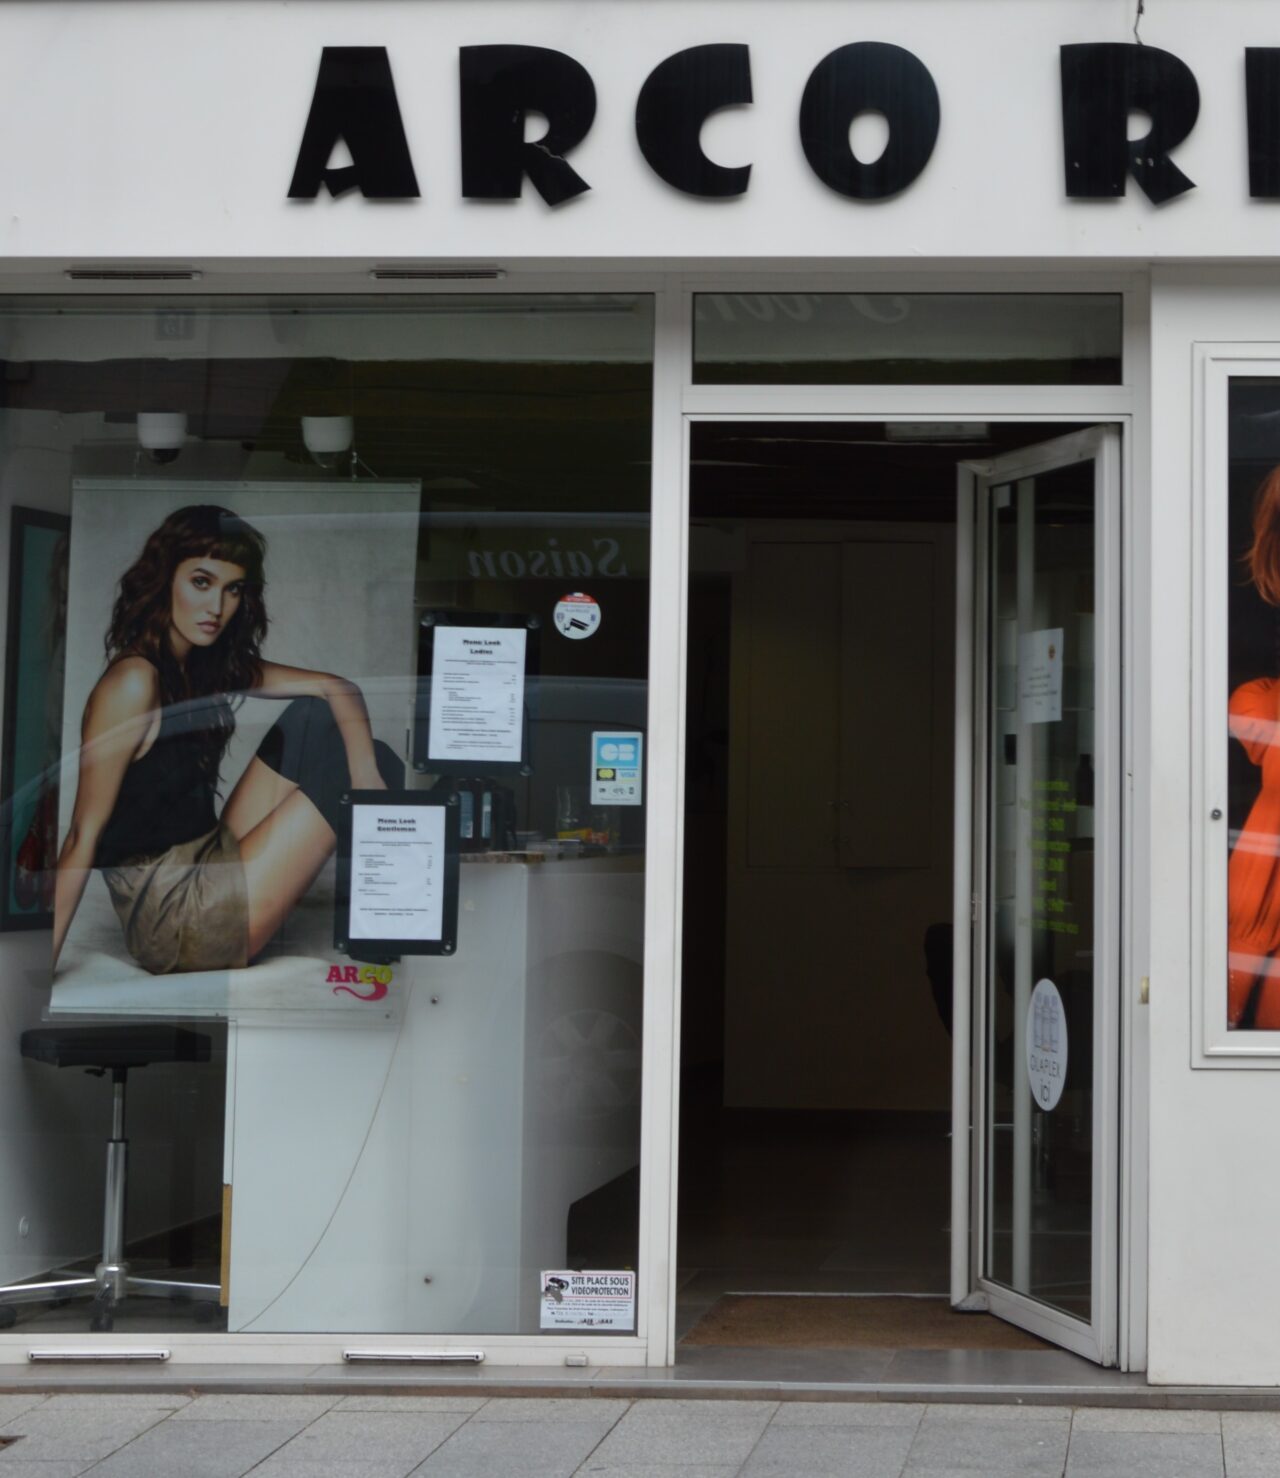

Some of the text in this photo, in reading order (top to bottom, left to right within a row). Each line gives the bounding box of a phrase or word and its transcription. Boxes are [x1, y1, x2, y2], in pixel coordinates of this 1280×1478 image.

[288, 42, 940, 206] ARCO
[600, 743, 635, 761] CB
[326, 965, 392, 984] ARCO
[571, 1275, 629, 1286] SITE PLACÉ SOUS
